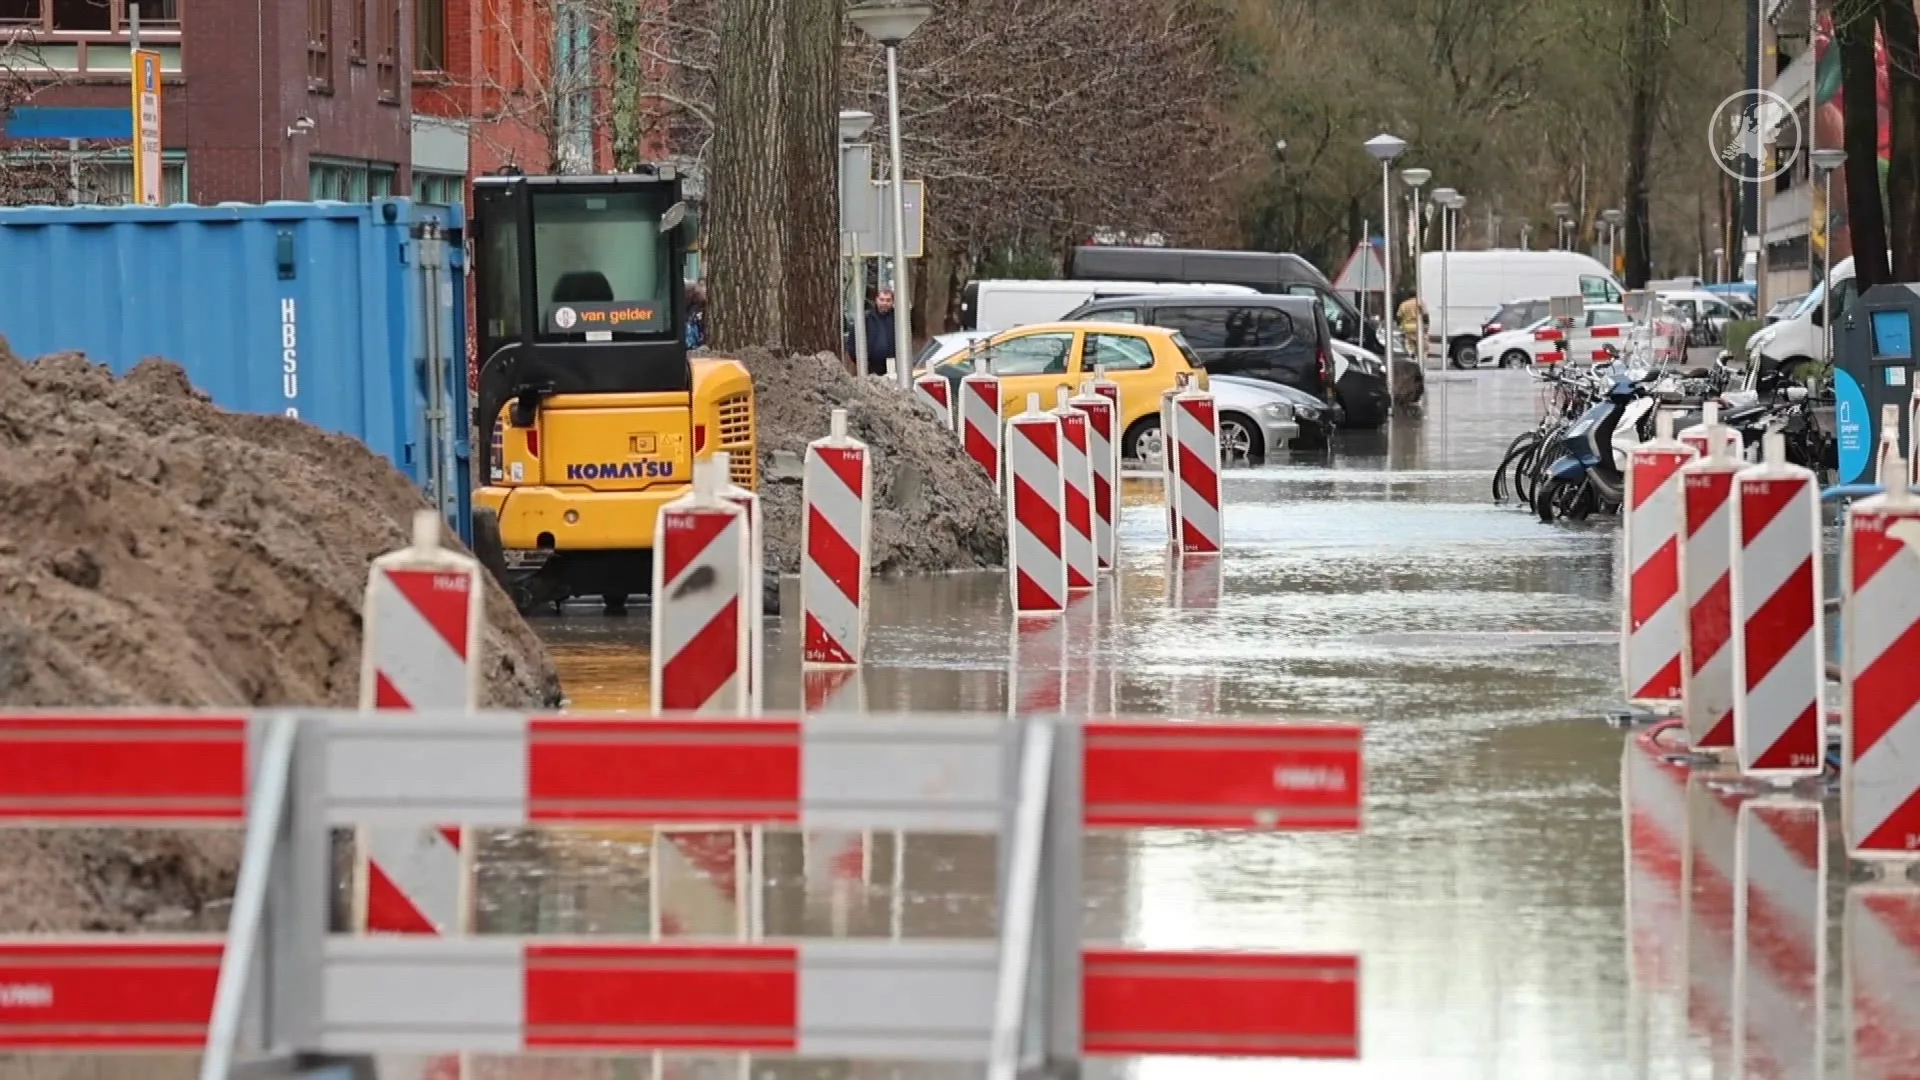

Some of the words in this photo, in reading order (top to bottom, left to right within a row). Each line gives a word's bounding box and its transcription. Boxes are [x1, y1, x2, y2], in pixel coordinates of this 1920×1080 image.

[581, 311, 605, 321] van
[610, 307, 653, 325] gelder
[281, 298, 298, 399] HBSU
[842, 450, 863, 460] HvE
[567, 457, 673, 480] KOMATSU
[1743, 482, 1770, 494] HvE
[667, 516, 696, 529] HvE
